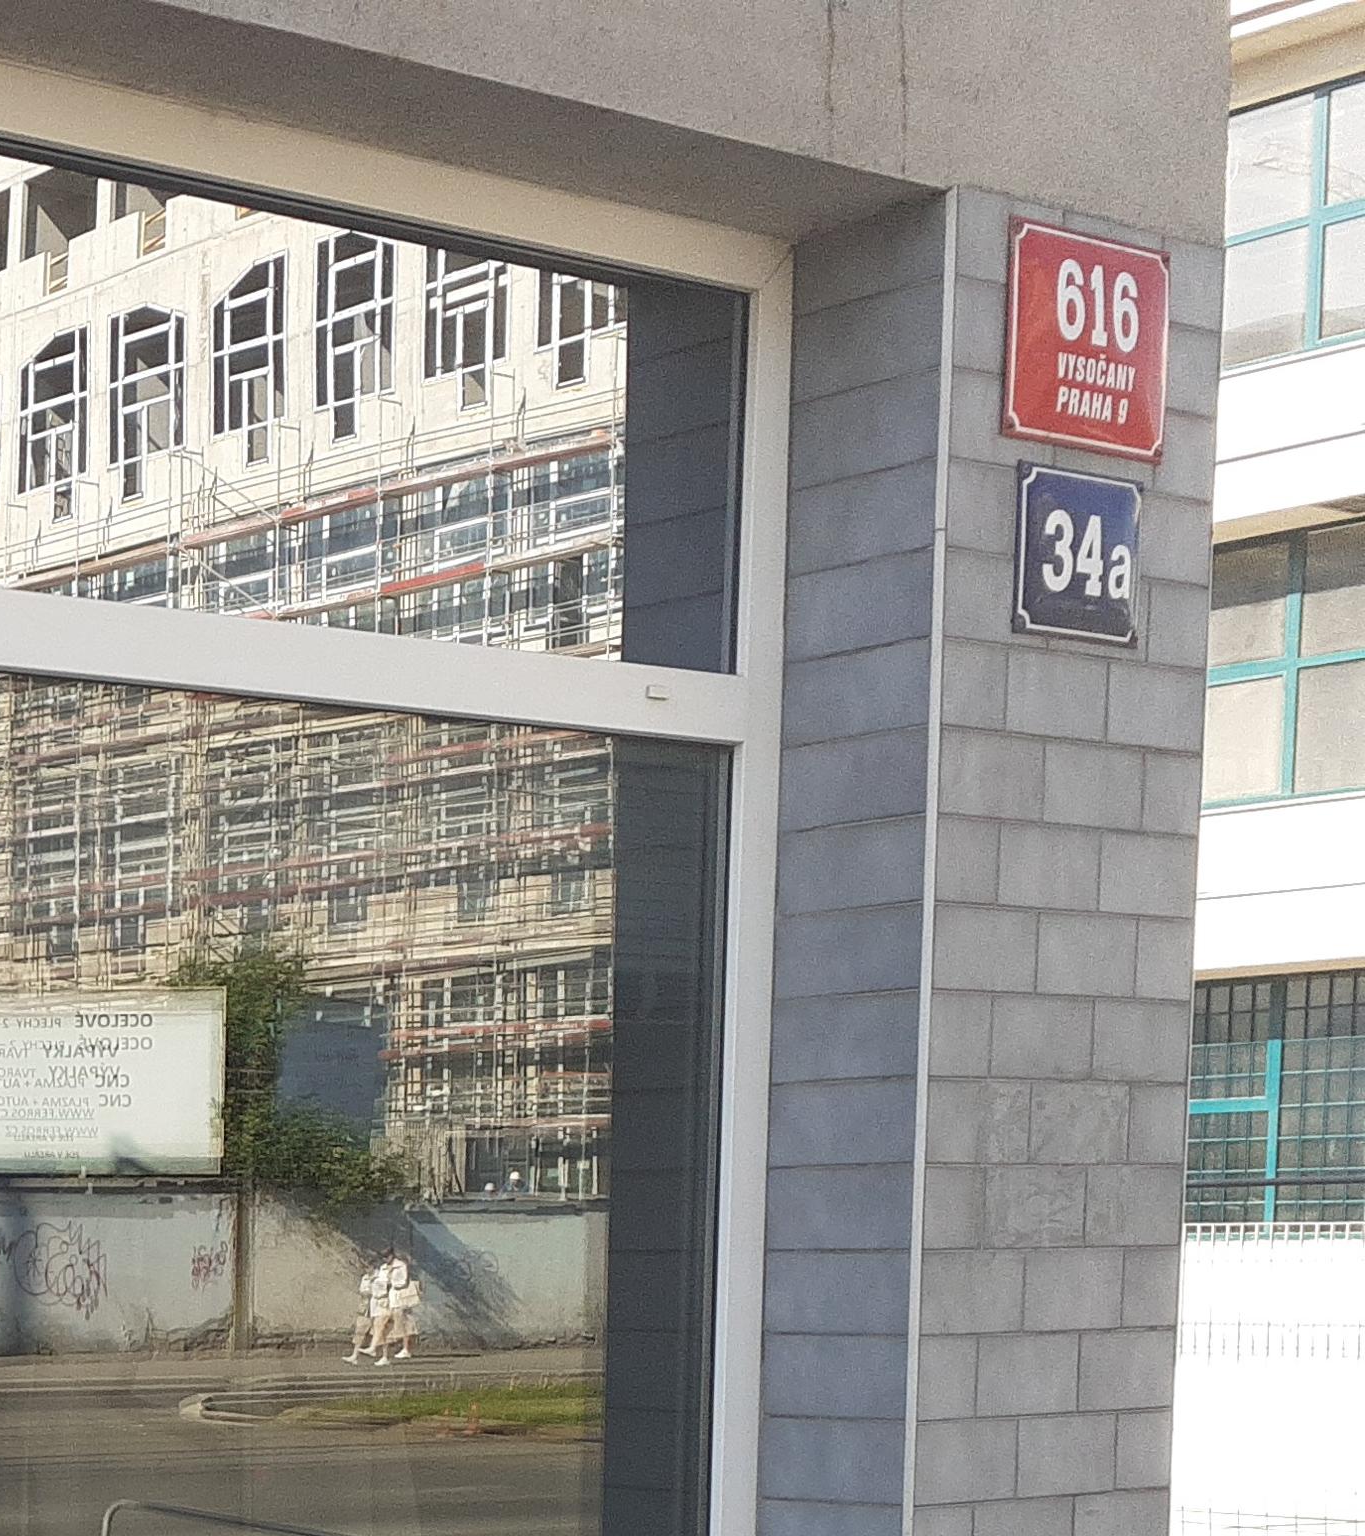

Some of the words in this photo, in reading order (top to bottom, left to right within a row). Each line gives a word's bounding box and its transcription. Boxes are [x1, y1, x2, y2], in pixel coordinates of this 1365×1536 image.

[1056, 258, 1140, 352] 616
[1055, 387, 1113, 421] PRAHA
[1117, 398, 1130, 425] 9
[1057, 351, 1136, 394] VYSOČANY
[1042, 508, 1131, 599] 34a
